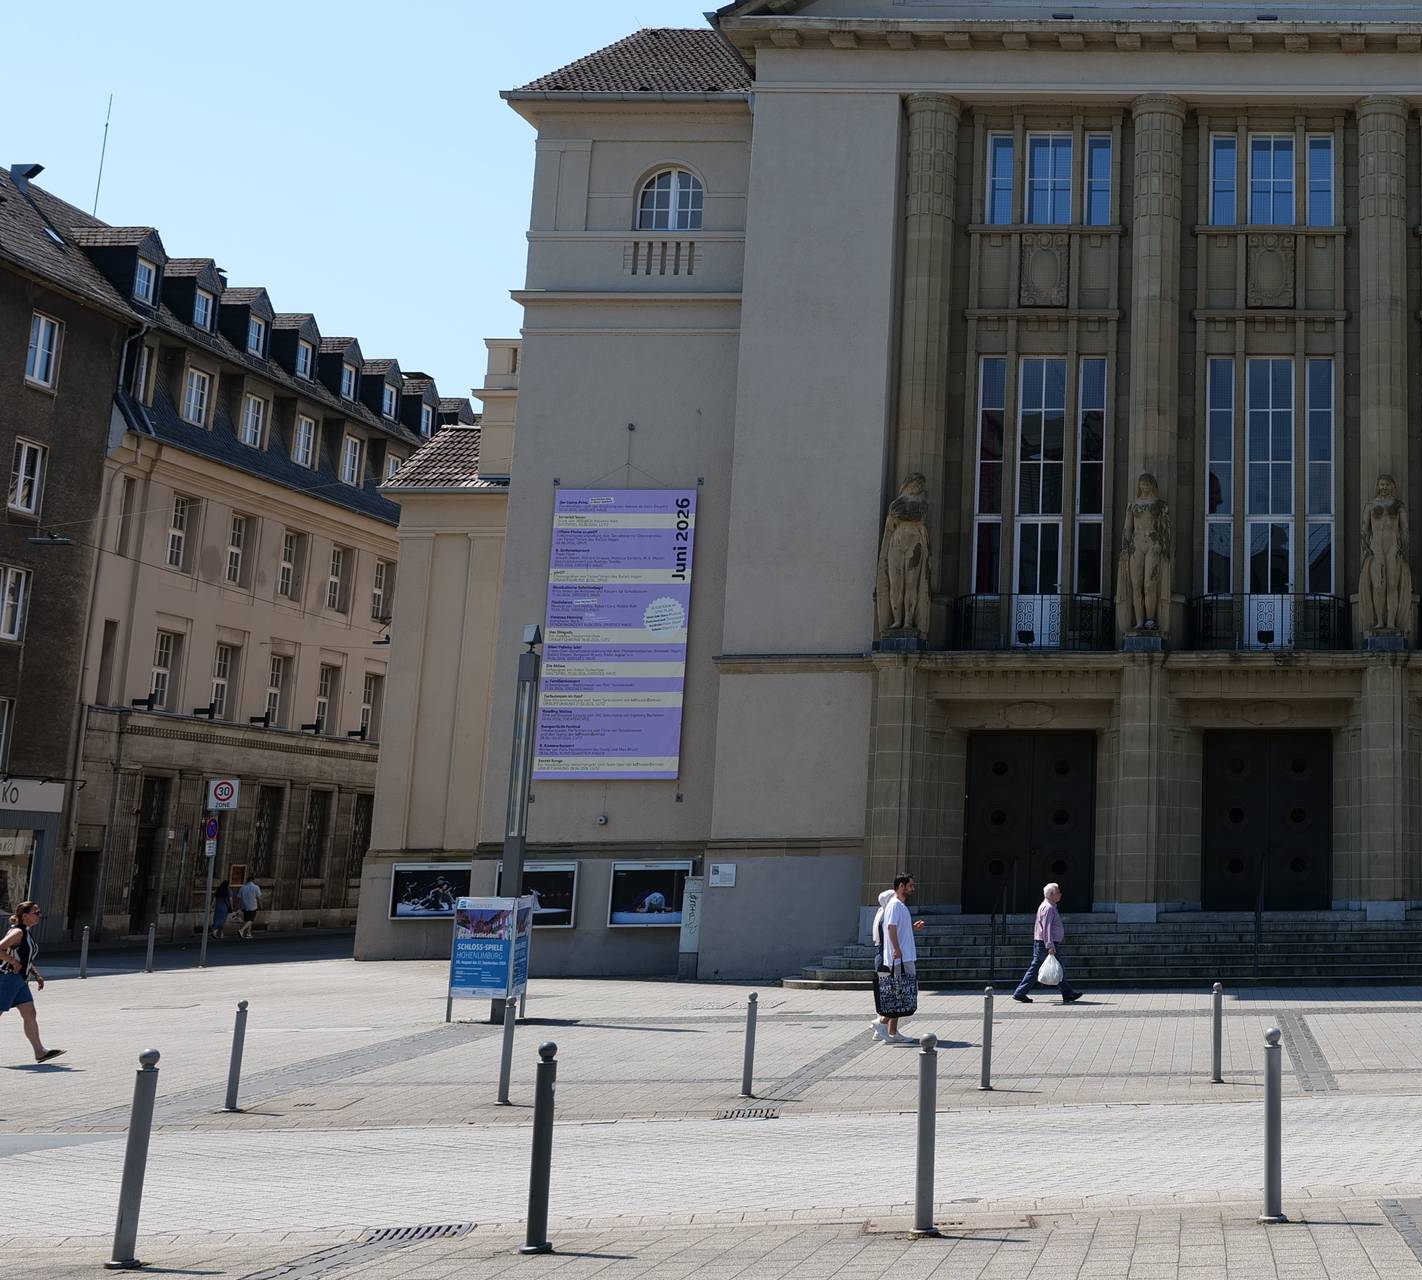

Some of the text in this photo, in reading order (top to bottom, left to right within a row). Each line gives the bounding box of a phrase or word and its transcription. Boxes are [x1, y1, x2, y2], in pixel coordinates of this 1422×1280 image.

[671, 498, 690, 581] Juni 2026
[218, 787, 230, 796] 30
[457, 943, 504, 951] SCHLOSS-SPIELE
[456, 951, 503, 960] HOHENLIMBURG
